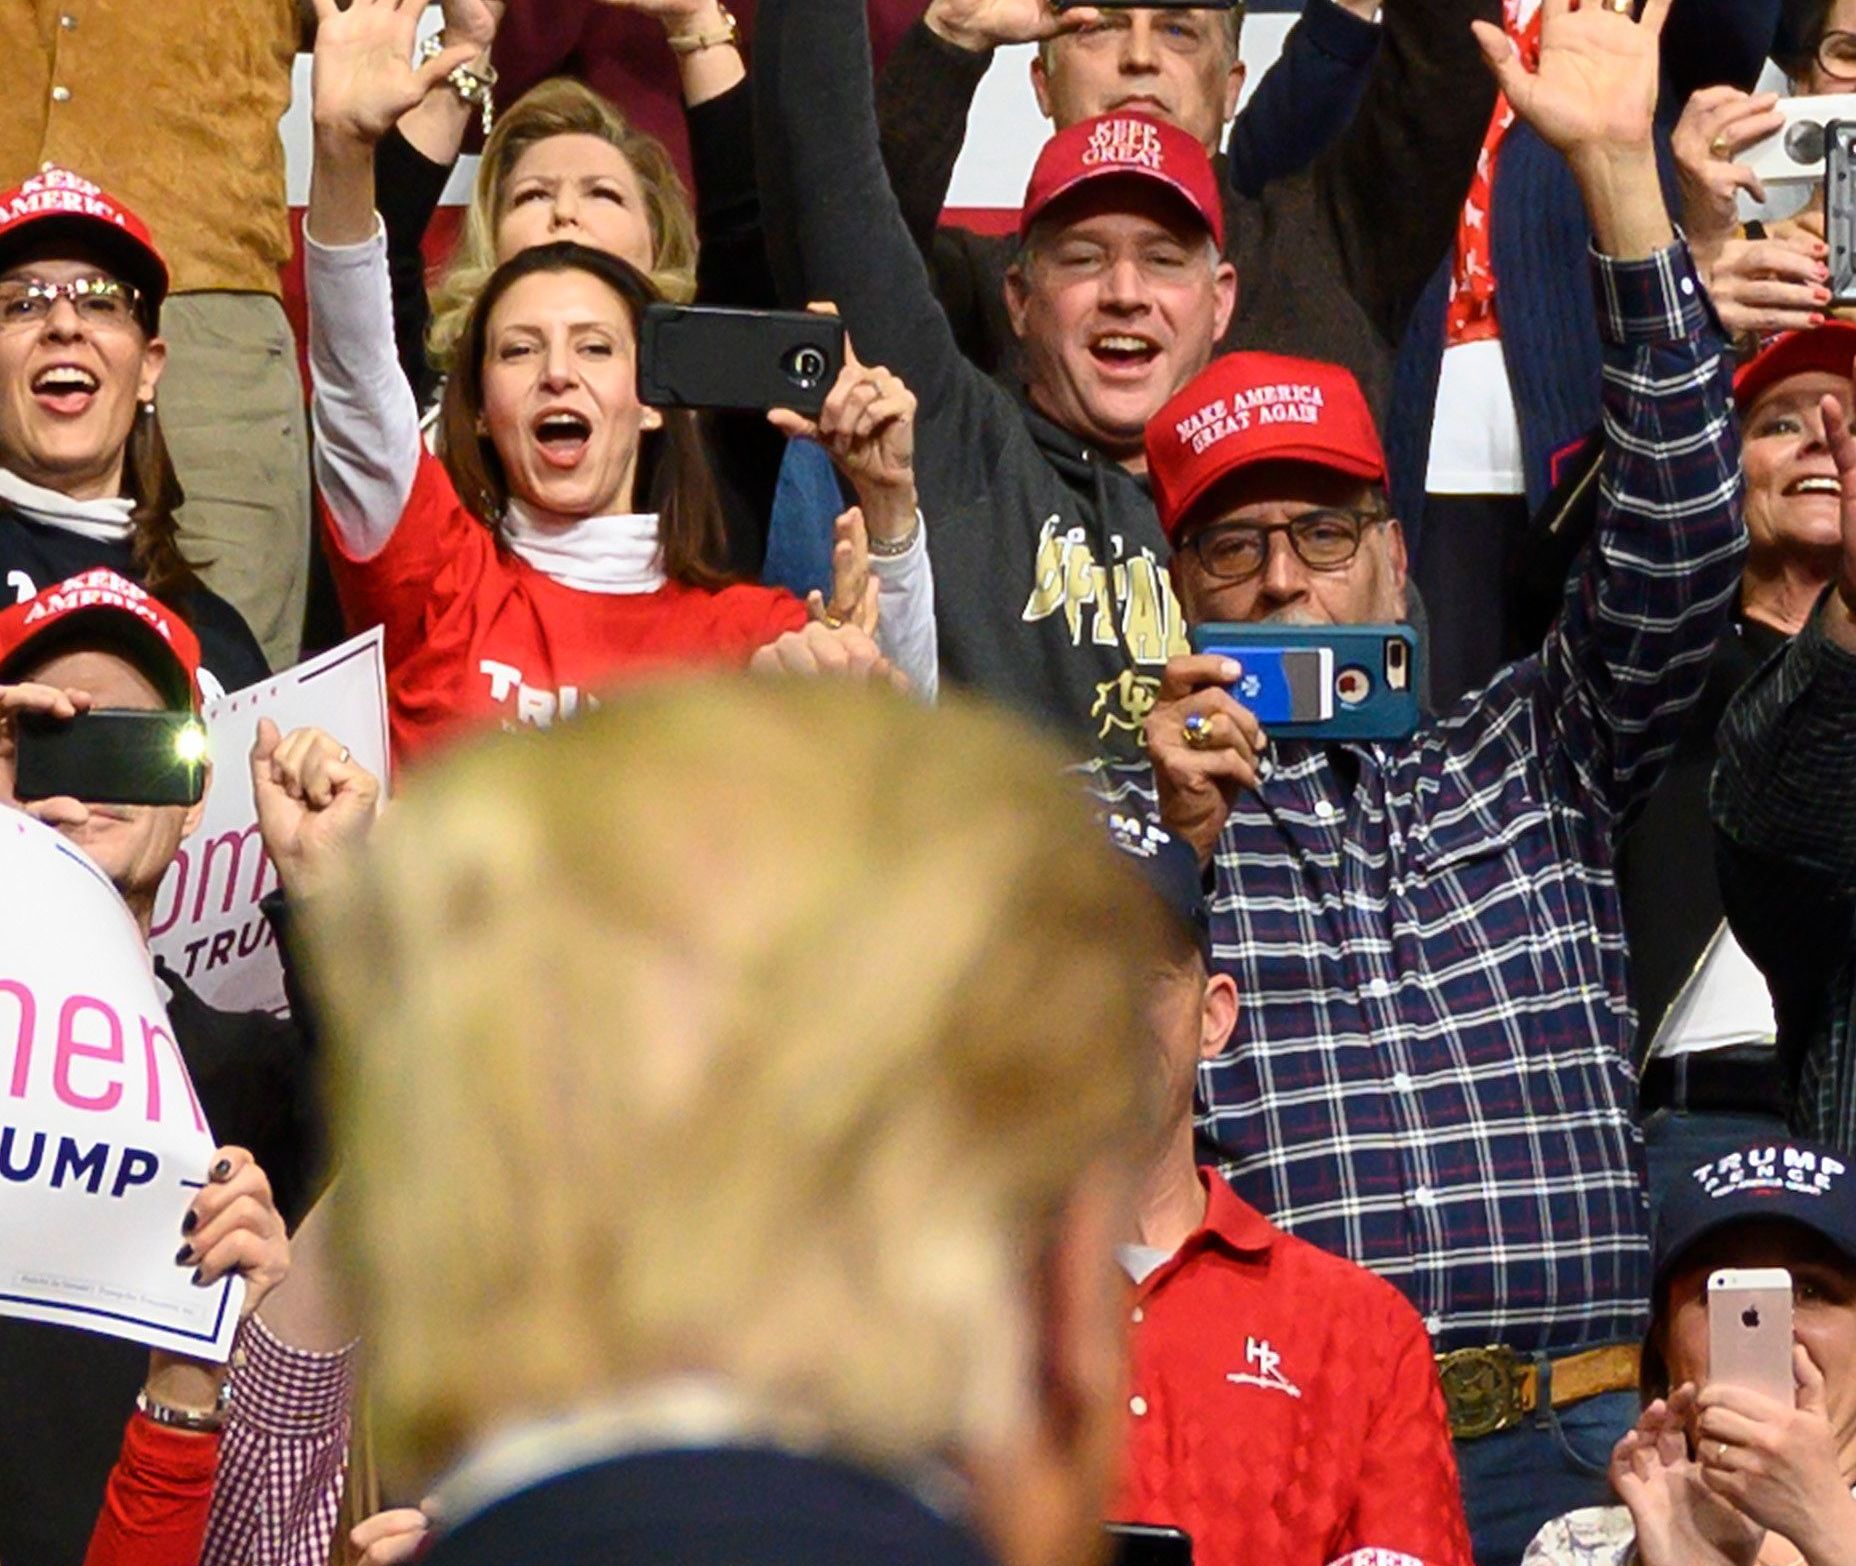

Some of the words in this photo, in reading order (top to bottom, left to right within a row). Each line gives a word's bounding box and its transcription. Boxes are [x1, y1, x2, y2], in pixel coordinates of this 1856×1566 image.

[1233, 384, 1324, 413] AMERICA
[1192, 411, 1251, 455] GREAT
[1258, 403, 1319, 425] AGAIN
[184, 917, 274, 979] TRU
[1693, 1147, 1845, 1182] TRUMP
